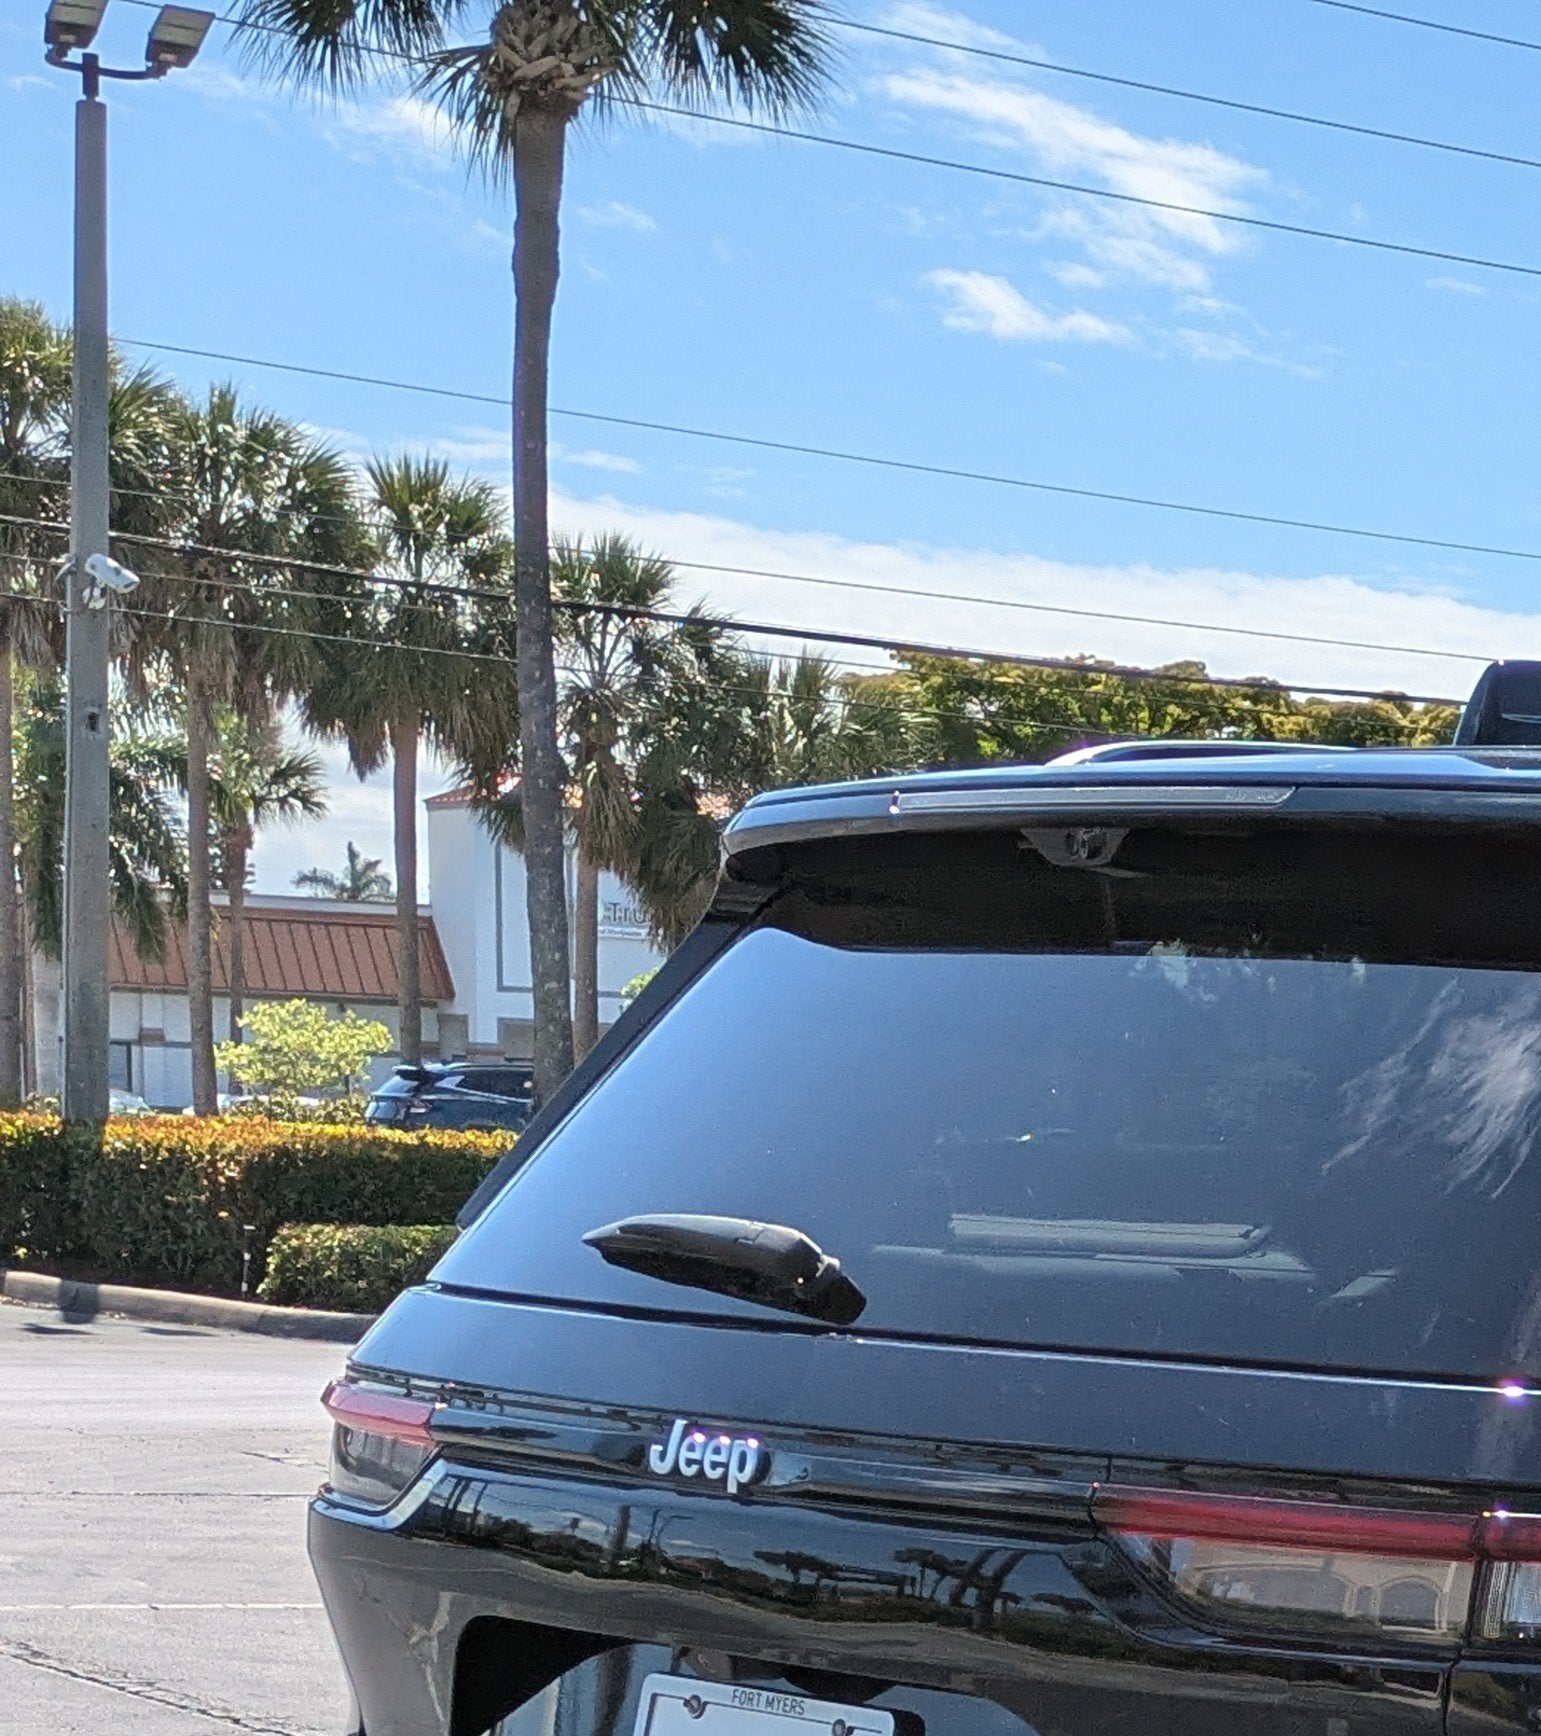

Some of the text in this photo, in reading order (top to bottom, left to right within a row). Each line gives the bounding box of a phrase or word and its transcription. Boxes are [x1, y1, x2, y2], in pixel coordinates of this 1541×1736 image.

[650, 1419, 759, 1494] Jeep
[731, 1688, 806, 1716] FORT MYERS
